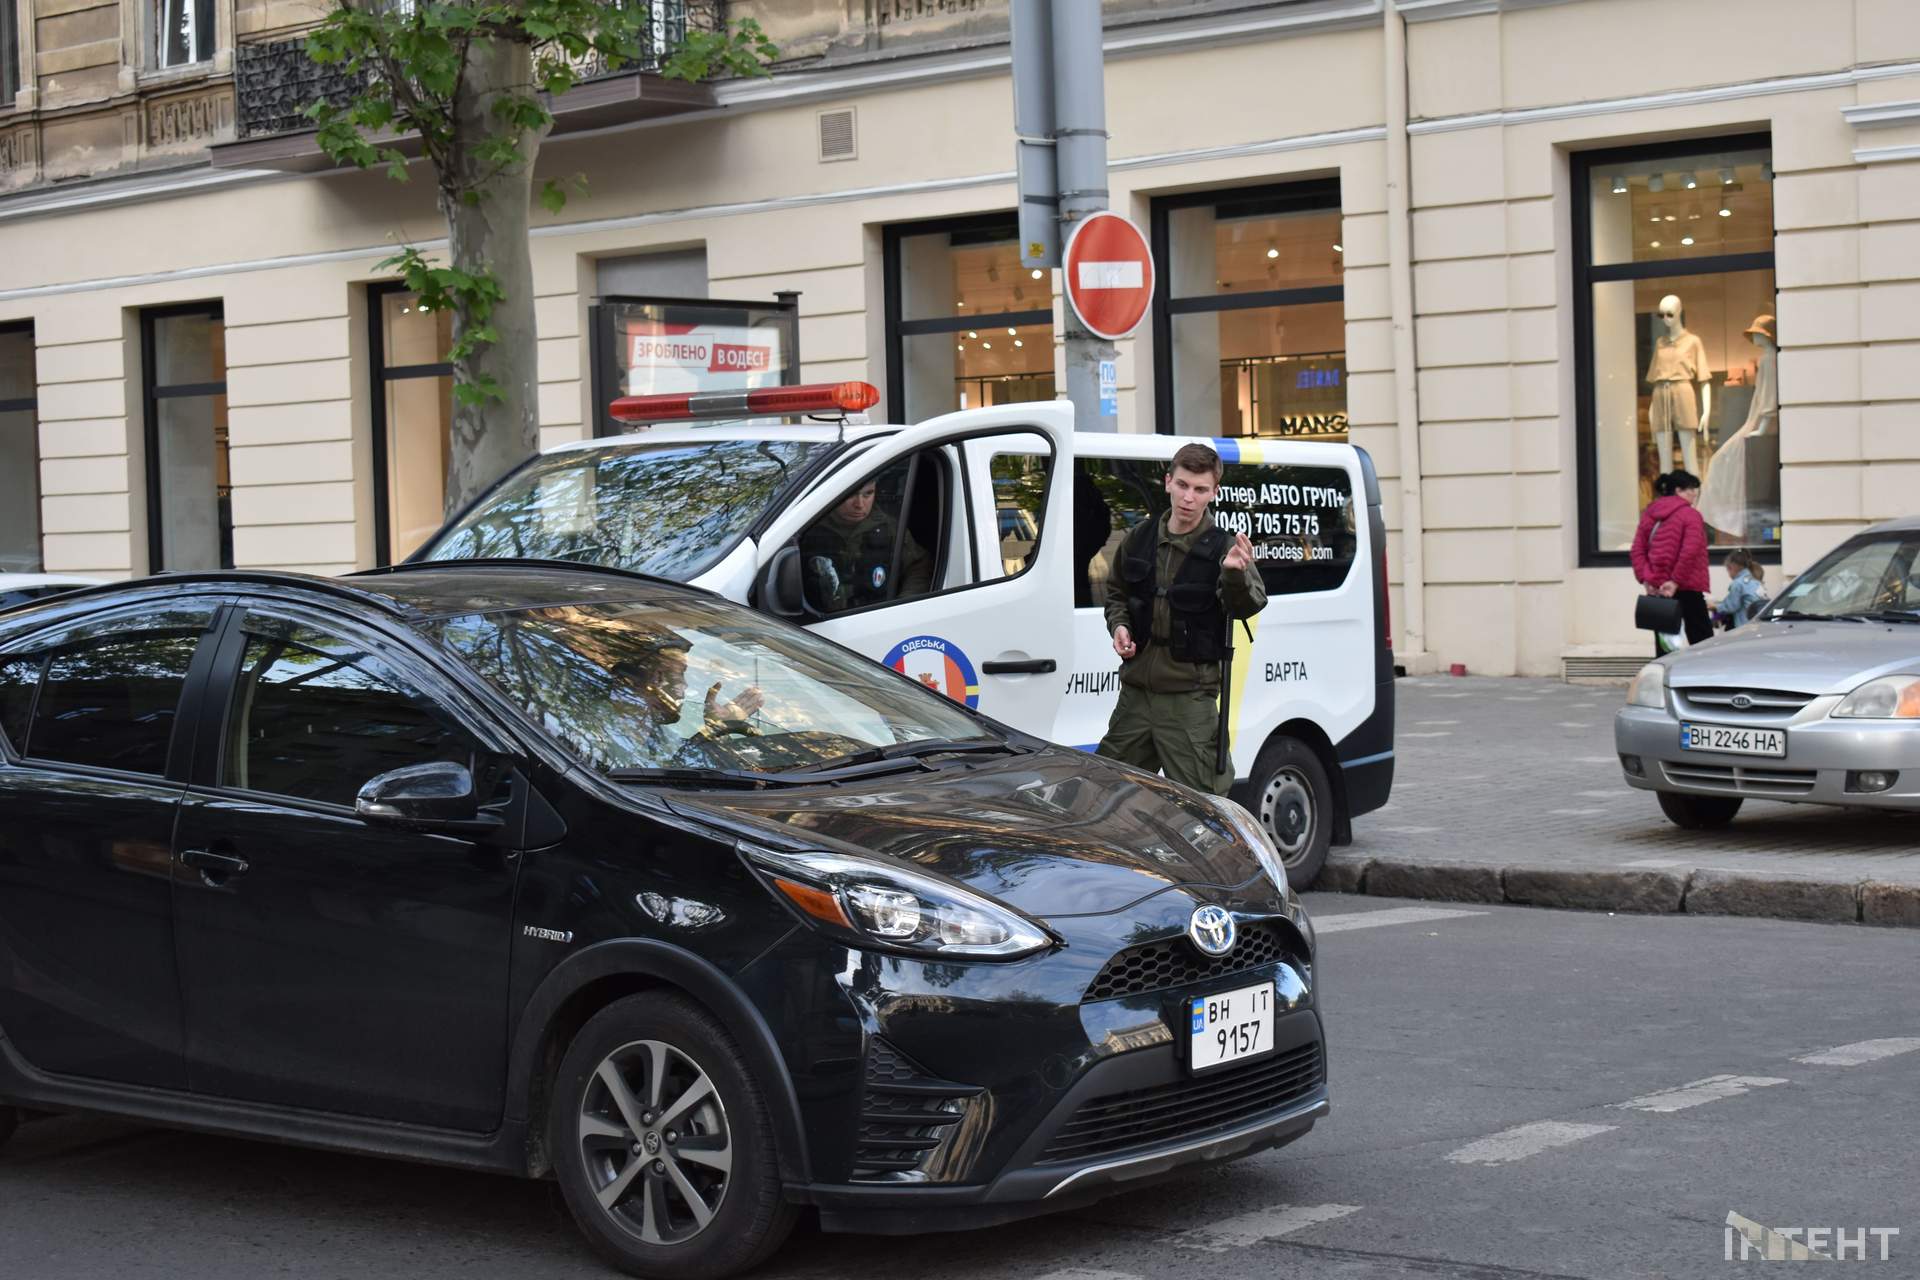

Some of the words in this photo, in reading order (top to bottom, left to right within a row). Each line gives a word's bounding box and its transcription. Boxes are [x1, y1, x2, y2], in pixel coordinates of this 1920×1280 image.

[638, 343, 707, 360] ЗРОБЛЕНО
[718, 351, 725, 364] В
[727, 352, 764, 368] ОДЕСІ
[1210, 486, 1256, 508] ртнер
[1260, 483, 1300, 506] АВТО
[1214, 511, 1252, 538] (048)
[1255, 513, 1281, 534] 705
[1283, 514, 1301, 534] 75
[1303, 515, 1320, 535] 75
[1252, 542, 1333, 560] ult-odess.com
[901, 639, 946, 653] ОДЕСЬКА
[1065, 671, 1121, 696] УНІЦИП
[1265, 661, 1308, 682] ВАРТА
[1690, 728, 1711, 746] BH
[1714, 730, 1750, 749] 2246
[1754, 733, 1778, 751] HA
[523, 925, 566, 942] HYBRID
[1209, 999, 1231, 1023] BH
[1252, 989, 1269, 1013] IT
[1217, 1020, 1260, 1059] 9157
